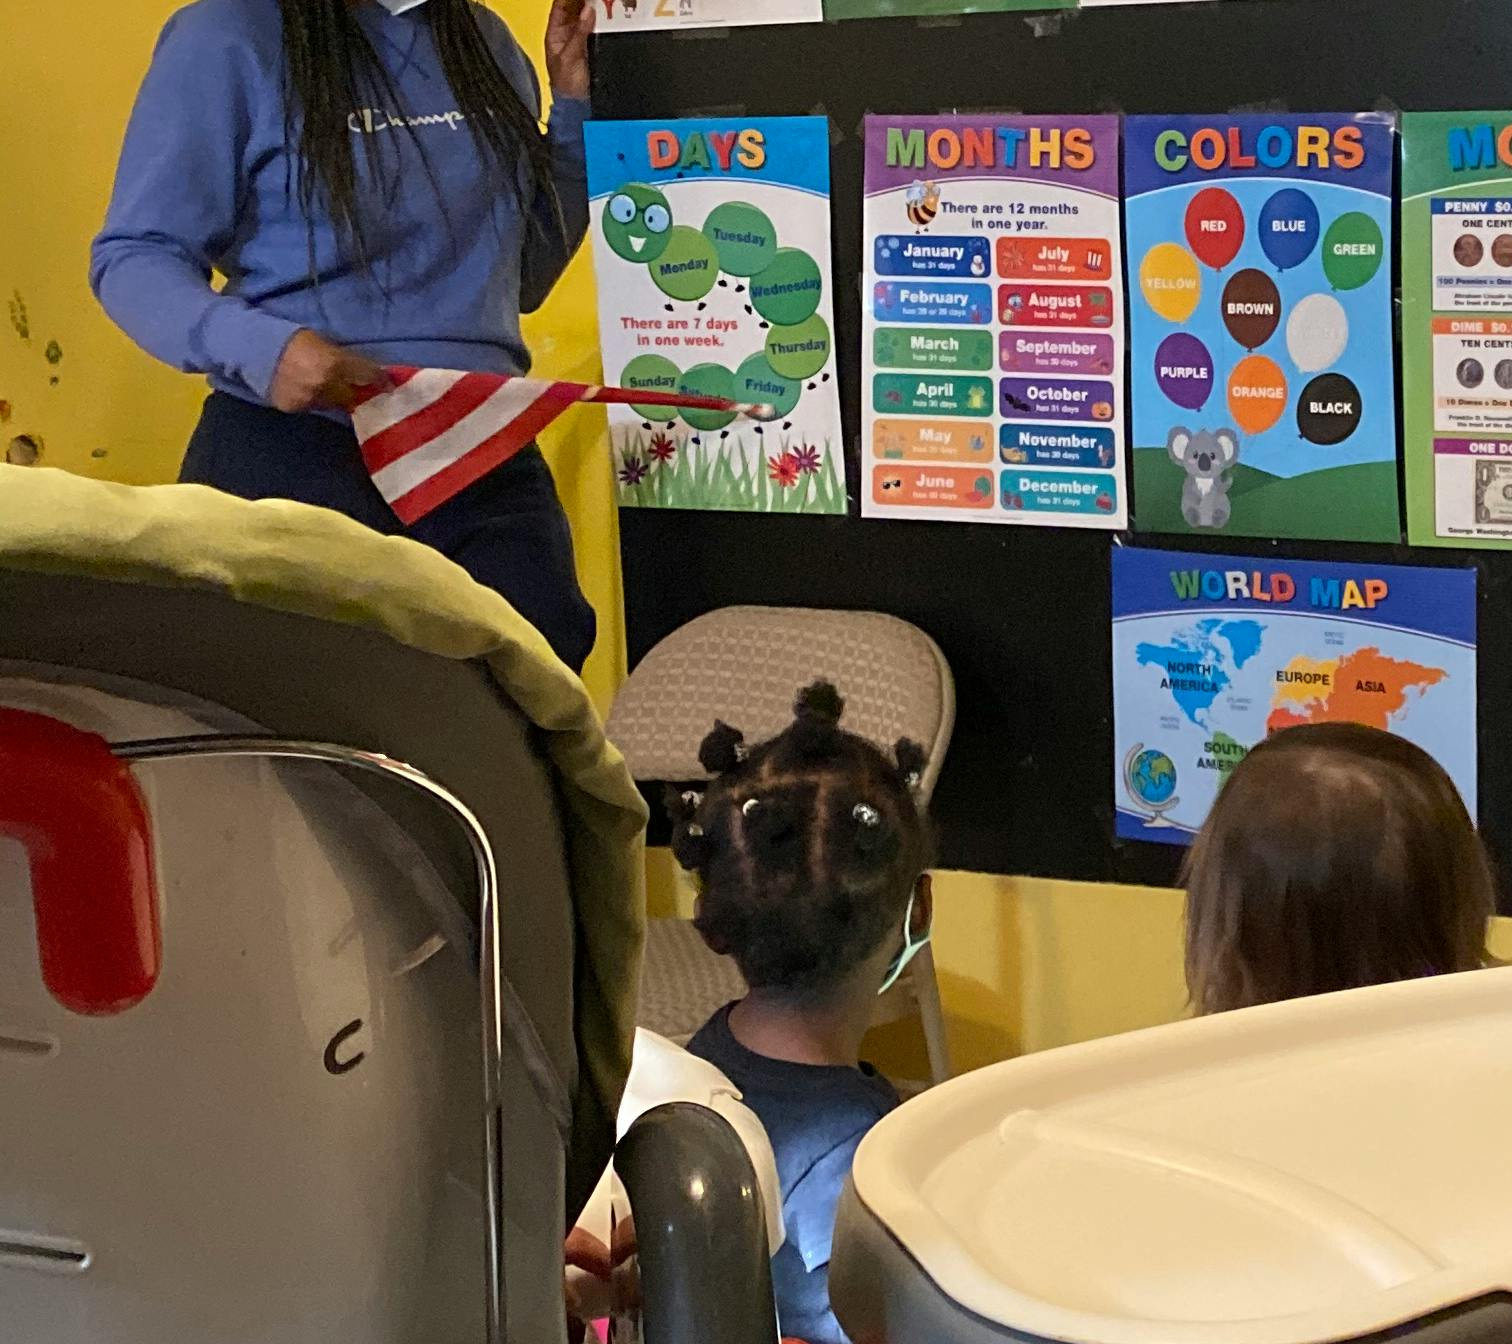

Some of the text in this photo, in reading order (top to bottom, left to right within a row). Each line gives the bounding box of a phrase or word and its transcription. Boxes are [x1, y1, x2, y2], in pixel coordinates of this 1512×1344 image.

[647, 129, 766, 171] DAYS
[886, 127, 1095, 170] MONTHS
[1154, 125, 1365, 171] COLORS
[941, 202, 1078, 215] There are 12 months
[1445, 202, 1486, 212] PENNY
[972, 217, 983, 229] in
[988, 218, 1011, 230] one
[1201, 220, 1226, 232] RED
[1272, 221, 1306, 232] BLUE
[1462, 220, 1512, 228] ONE CENT
[713, 228, 766, 247] Tuesday
[903, 244, 964, 260] January
[1038, 246, 1069, 262] July
[1333, 244, 1375, 255] GREEN
[660, 258, 709, 276] Monday
[752, 279, 821, 298] Wednesday
[1147, 278, 1195, 289] YELLOW
[900, 290, 969, 305] February
[1028, 292, 1082, 309] August
[1227, 303, 1274, 315] BROWN
[620, 317, 662, 329] There
[667, 320, 688, 329] are
[706, 318, 738, 332] days
[1451, 322, 1483, 333] DIME
[637, 335, 650, 345] in
[655, 336, 680, 345] one
[770, 339, 826, 355] Thursday
[910, 336, 959, 351] March
[1462, 340, 1481, 348] TEN
[1016, 340, 1096, 355] September
[1160, 367, 1208, 379] PURPLE
[629, 375, 675, 388] Sunday
[745, 378, 785, 396] Friday
[916, 383, 954, 397] April
[1026, 386, 1088, 402] October
[1232, 387, 1284, 399] ORANGE
[1309, 402, 1352, 414] BLACK
[919, 429, 952, 443] May
[1019, 432, 1096, 448] November
[1469, 443, 1496, 454] ONE
[915, 474, 955, 488] June
[1019, 478, 1098, 494] December
[1170, 570, 1388, 610] WORLD MAP
[1167, 661, 1211, 675] NORTH
[1276, 671, 1330, 686] EUROPE
[1160, 679, 1218, 694] AMERICA
[1356, 680, 1386, 693] ASIA
